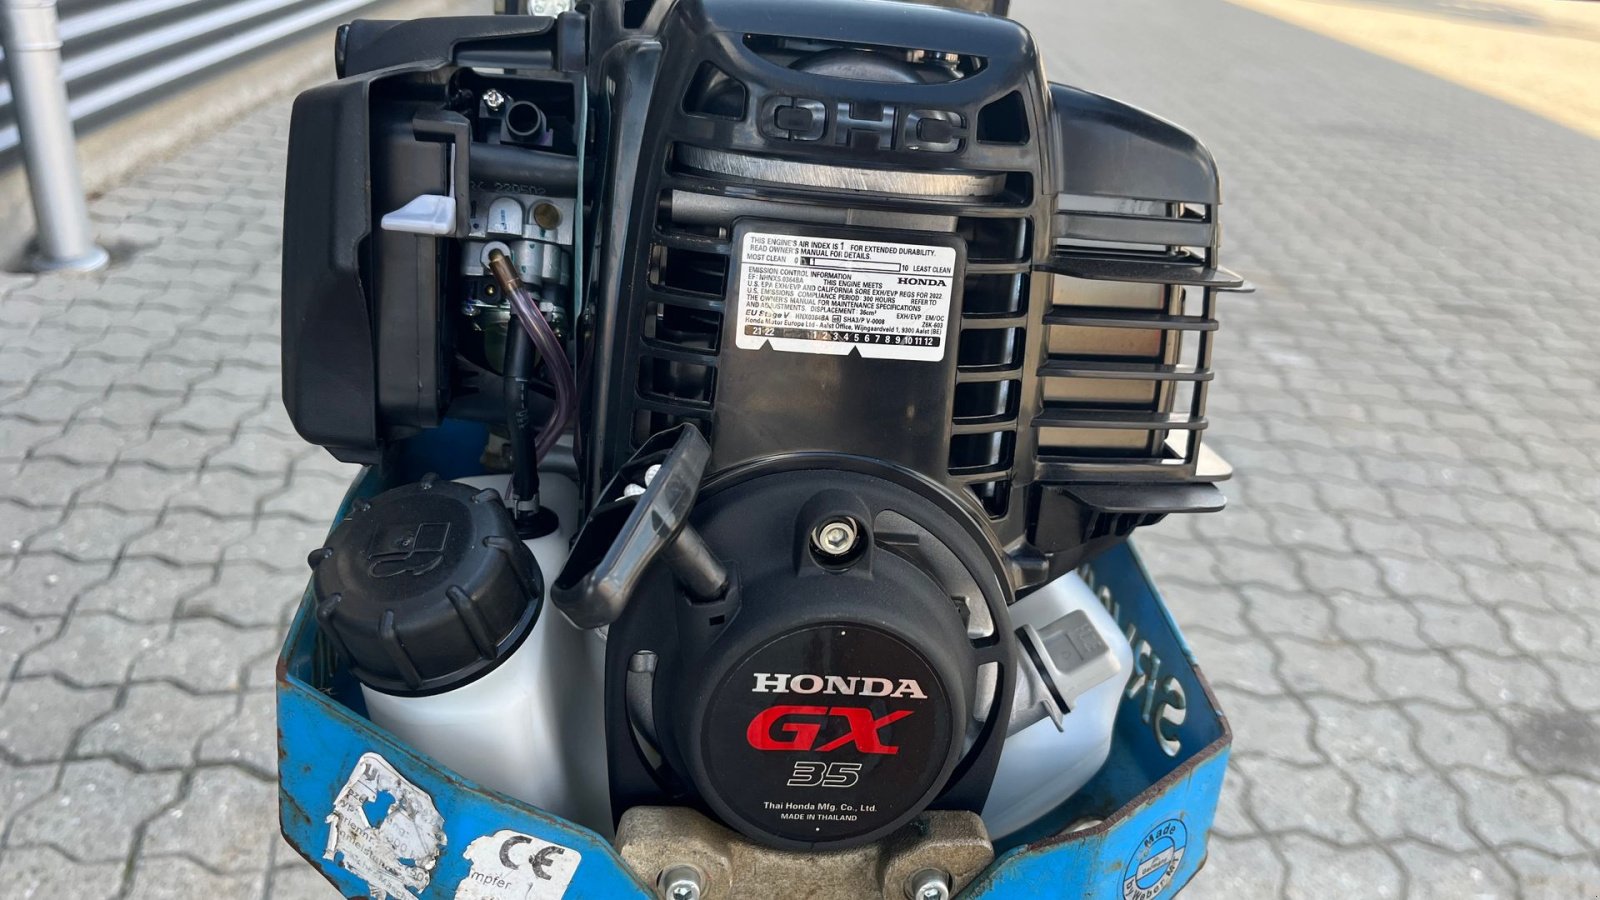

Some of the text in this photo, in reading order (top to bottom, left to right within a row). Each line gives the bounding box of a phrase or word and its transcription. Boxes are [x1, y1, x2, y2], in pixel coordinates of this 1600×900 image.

[760, 95, 967, 153] OHC
[769, 246, 799, 254] OWNER'S
[865, 246, 897, 254] EXTENDED
[899, 248, 936, 256] DURABILITY.
[780, 268, 809, 277] CONTROL
[810, 271, 852, 280] INFORMATION
[898, 277, 947, 287] HONDA
[817, 286, 852, 294] CALIFORNIA
[831, 300, 874, 309] MAINTENANCE
[876, 303, 921, 312] SPECIFICATIONS
[752, 673, 928, 699] HONDA
[746, 704, 915, 755] GX
[787, 762, 862, 788] 35
[764, 801, 783, 809] Thai
[818, 803, 838, 812] Mfg.
[840, 804, 858, 812] Co.,
[1144, 823, 1176, 847] Made
[499, 835, 565, 880] CE
[1126, 879, 1134, 896] by
